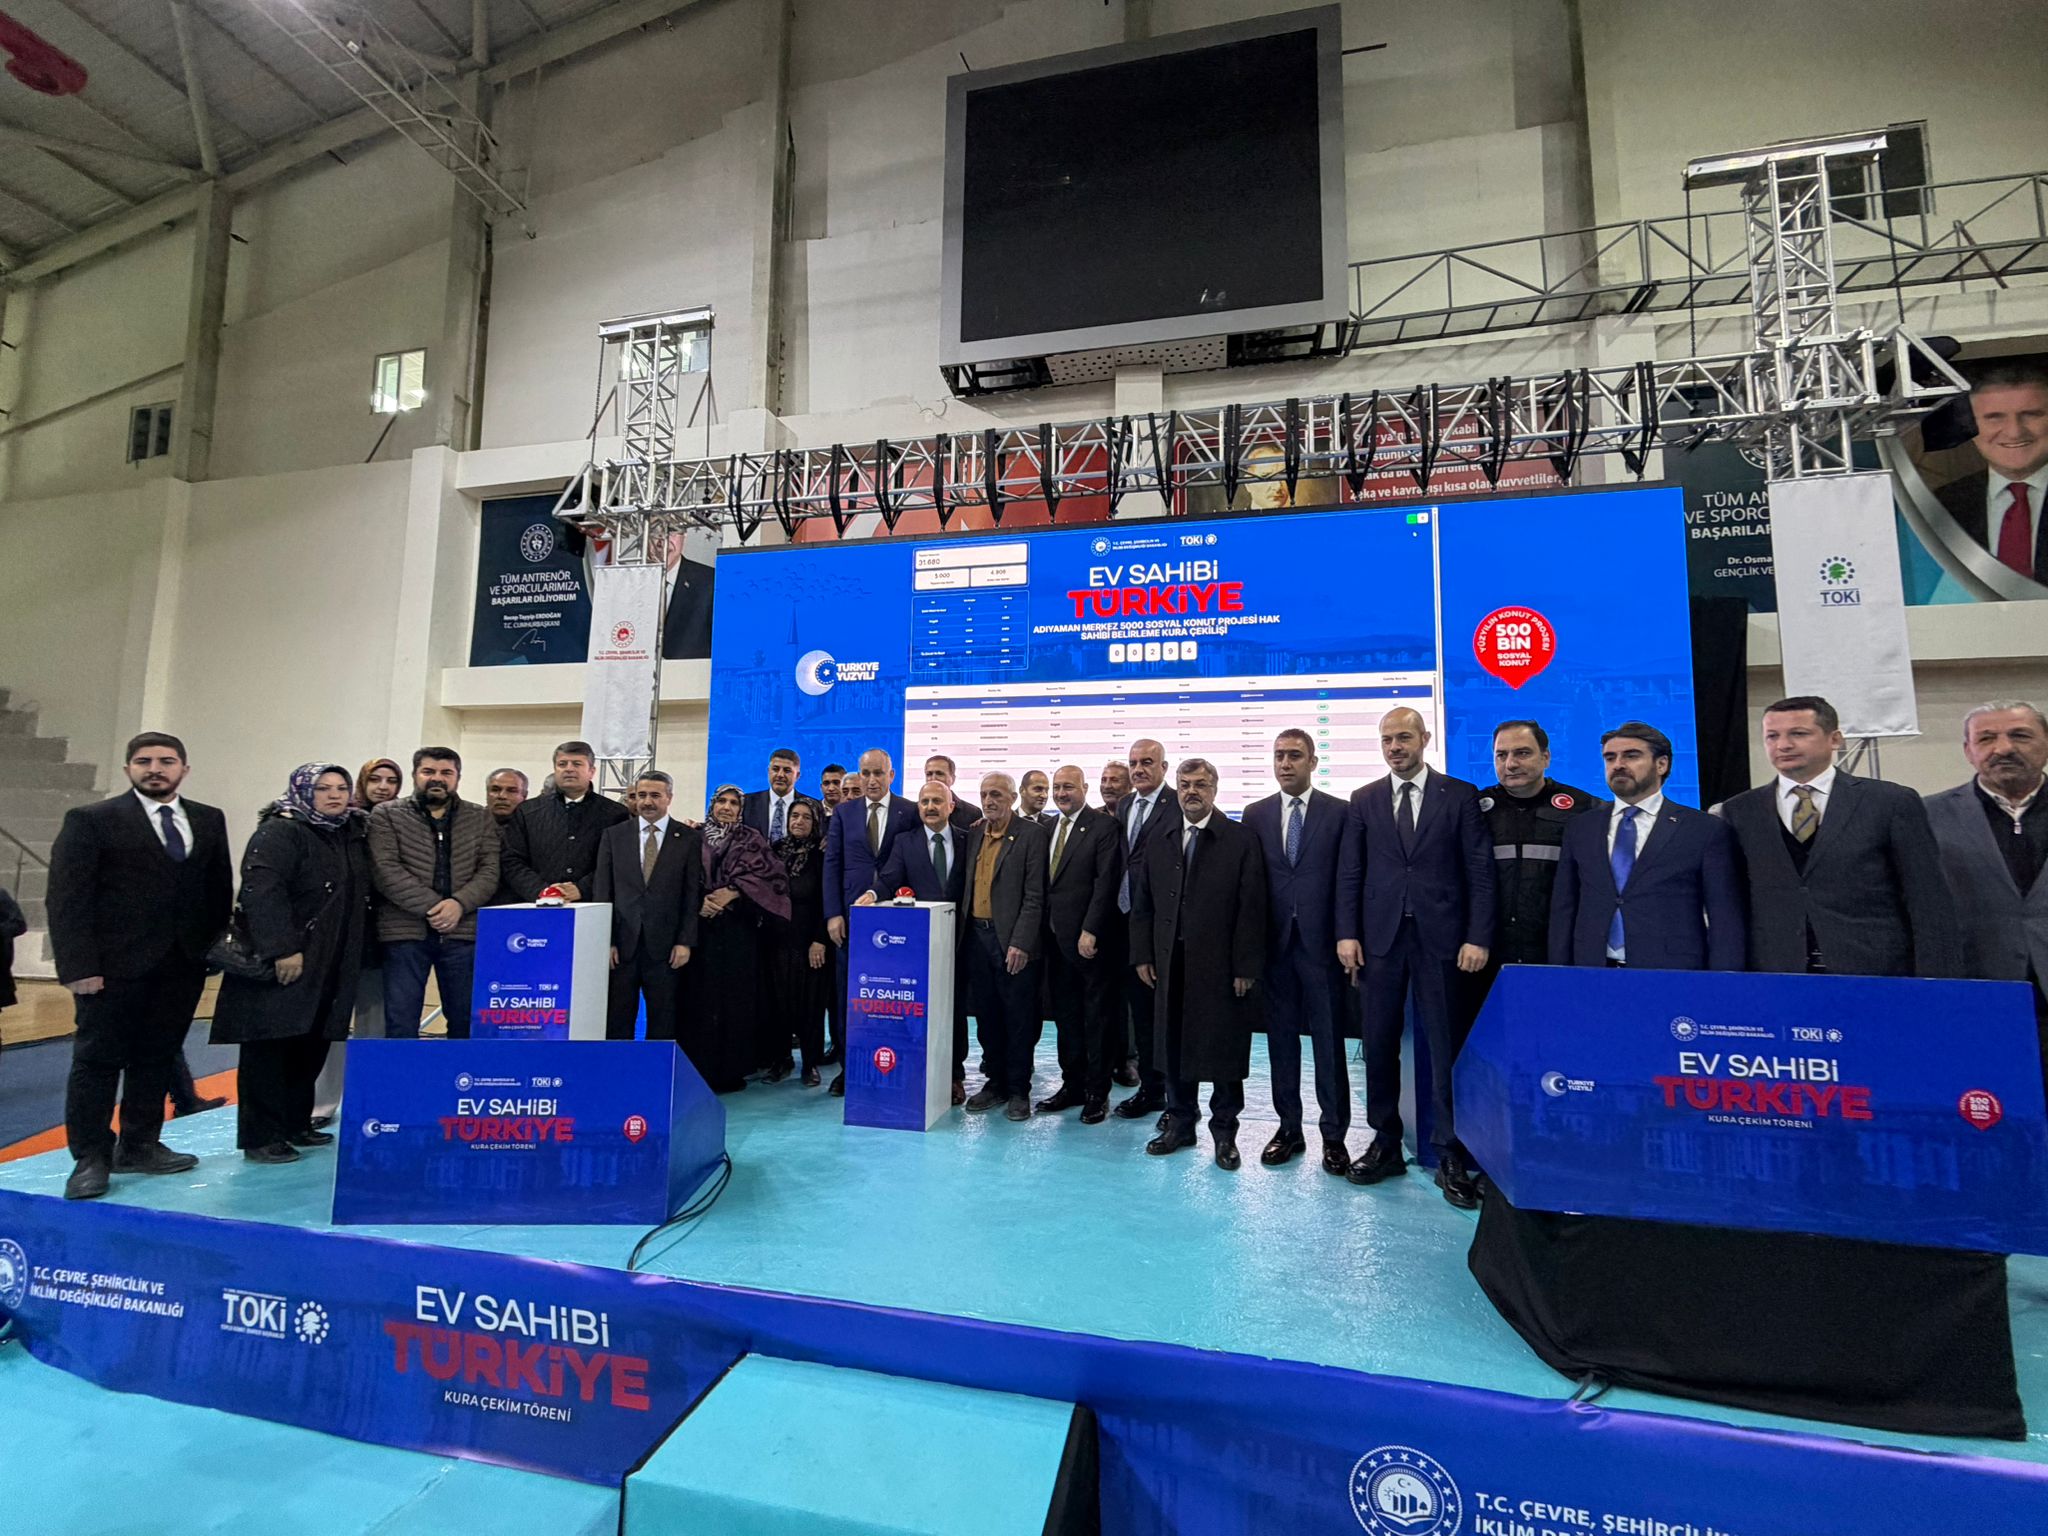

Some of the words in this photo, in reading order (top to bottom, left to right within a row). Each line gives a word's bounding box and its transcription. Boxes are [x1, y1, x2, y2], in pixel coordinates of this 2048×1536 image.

[1378, 488, 1391, 496] ve
[1392, 484, 1442, 496] kavraışı
[1444, 481, 1467, 492] kısa
[1702, 492, 1744, 508] TÜM
[1684, 510, 1706, 524] VE
[1727, 556, 1742, 565] Dr.
[500, 572, 520, 584] TÜM
[521, 570, 571, 583] ANTRENÖR
[1089, 565, 1123, 587] EV
[1714, 566, 1760, 578] GENÇLİK
[489, 585, 501, 595] VE
[501, 581, 580, 595] SPORCULARIMIZA
[491, 595, 533, 606] BAŞARILAR
[533, 593, 577, 603] DİLİYORUM
[1498, 610, 1532, 620] KONUT
[1033, 623, 1080, 634] ADIYAMAN
[1082, 622, 1118, 632] MERKEZ
[1120, 621, 1144, 630] 5000
[1145, 619, 1181, 629] SOSYAL
[1183, 617, 1216, 627] KONUT
[1218, 614, 1257, 626] PROJESİ
[1259, 615, 1280, 624] HAK
[1496, 623, 1532, 637] 500
[1081, 629, 1110, 640] SAHİBİ
[1111, 627, 1160, 639] BELİRLEME
[1161, 628, 1188, 637] KURA
[1190, 624, 1228, 637] ÇEKİLİŞİ
[1499, 659, 1531, 667] KONUT
[860, 988, 875, 998] EV
[489, 997, 508, 1008] EV
[1679, 1052, 1721, 1075] EV
[457, 1099, 485, 1115] EV
[1708, 1115, 1737, 1124] KURA
[1738, 1116, 1771, 1126] ÇEKİM
[1773, 1118, 1813, 1128] TÖRENİ
[33, 1266, 51, 1280] T.C.
[53, 1269, 89, 1287] ÇEVRE,
[91, 1273, 148, 1293] ŞEHİRCİLİK
[150, 1283, 165, 1295] VE
[30, 1283, 58, 1300] İKLİM
[59, 1289, 122, 1309] DEĞİŞİKLİĞİ
[123, 1299, 184, 1318] BAKANLIĞI
[416, 1285, 466, 1325] EV
[444, 1390, 479, 1406] KURA
[480, 1397, 522, 1414] ÇEKİM
[523, 1403, 572, 1422] TÖRENİ
[1475, 1492, 1514, 1514] T.C.
[1519, 1500, 1597, 1530] ÇEVRE,
